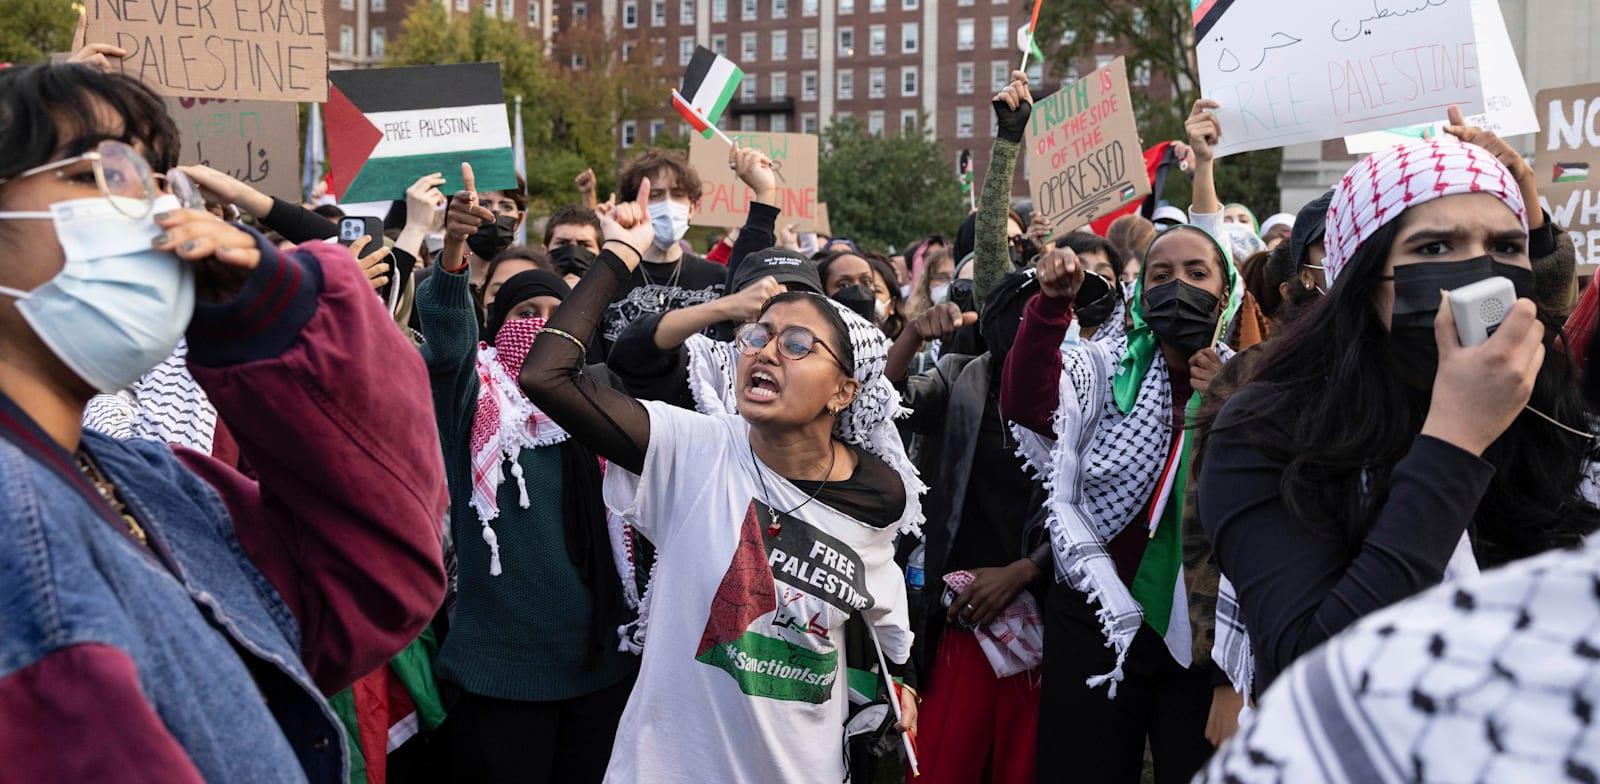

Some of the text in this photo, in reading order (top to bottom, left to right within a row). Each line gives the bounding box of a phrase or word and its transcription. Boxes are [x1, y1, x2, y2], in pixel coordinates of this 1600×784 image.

[94, 0, 324, 36] NEVER ERASE
[117, 32, 313, 92] PALESTINE
[1031, 68, 1113, 137] TRUTH IS
[1207, 42, 1477, 146] FREE PALESTINE
[384, 116, 479, 141] FREE PALESTINE
[1037, 94, 1119, 155] ON THE SIDE
[1051, 126, 1104, 170] OF THE
[1039, 140, 1126, 217] OPPRESSED
[809, 540, 855, 580] FREE
